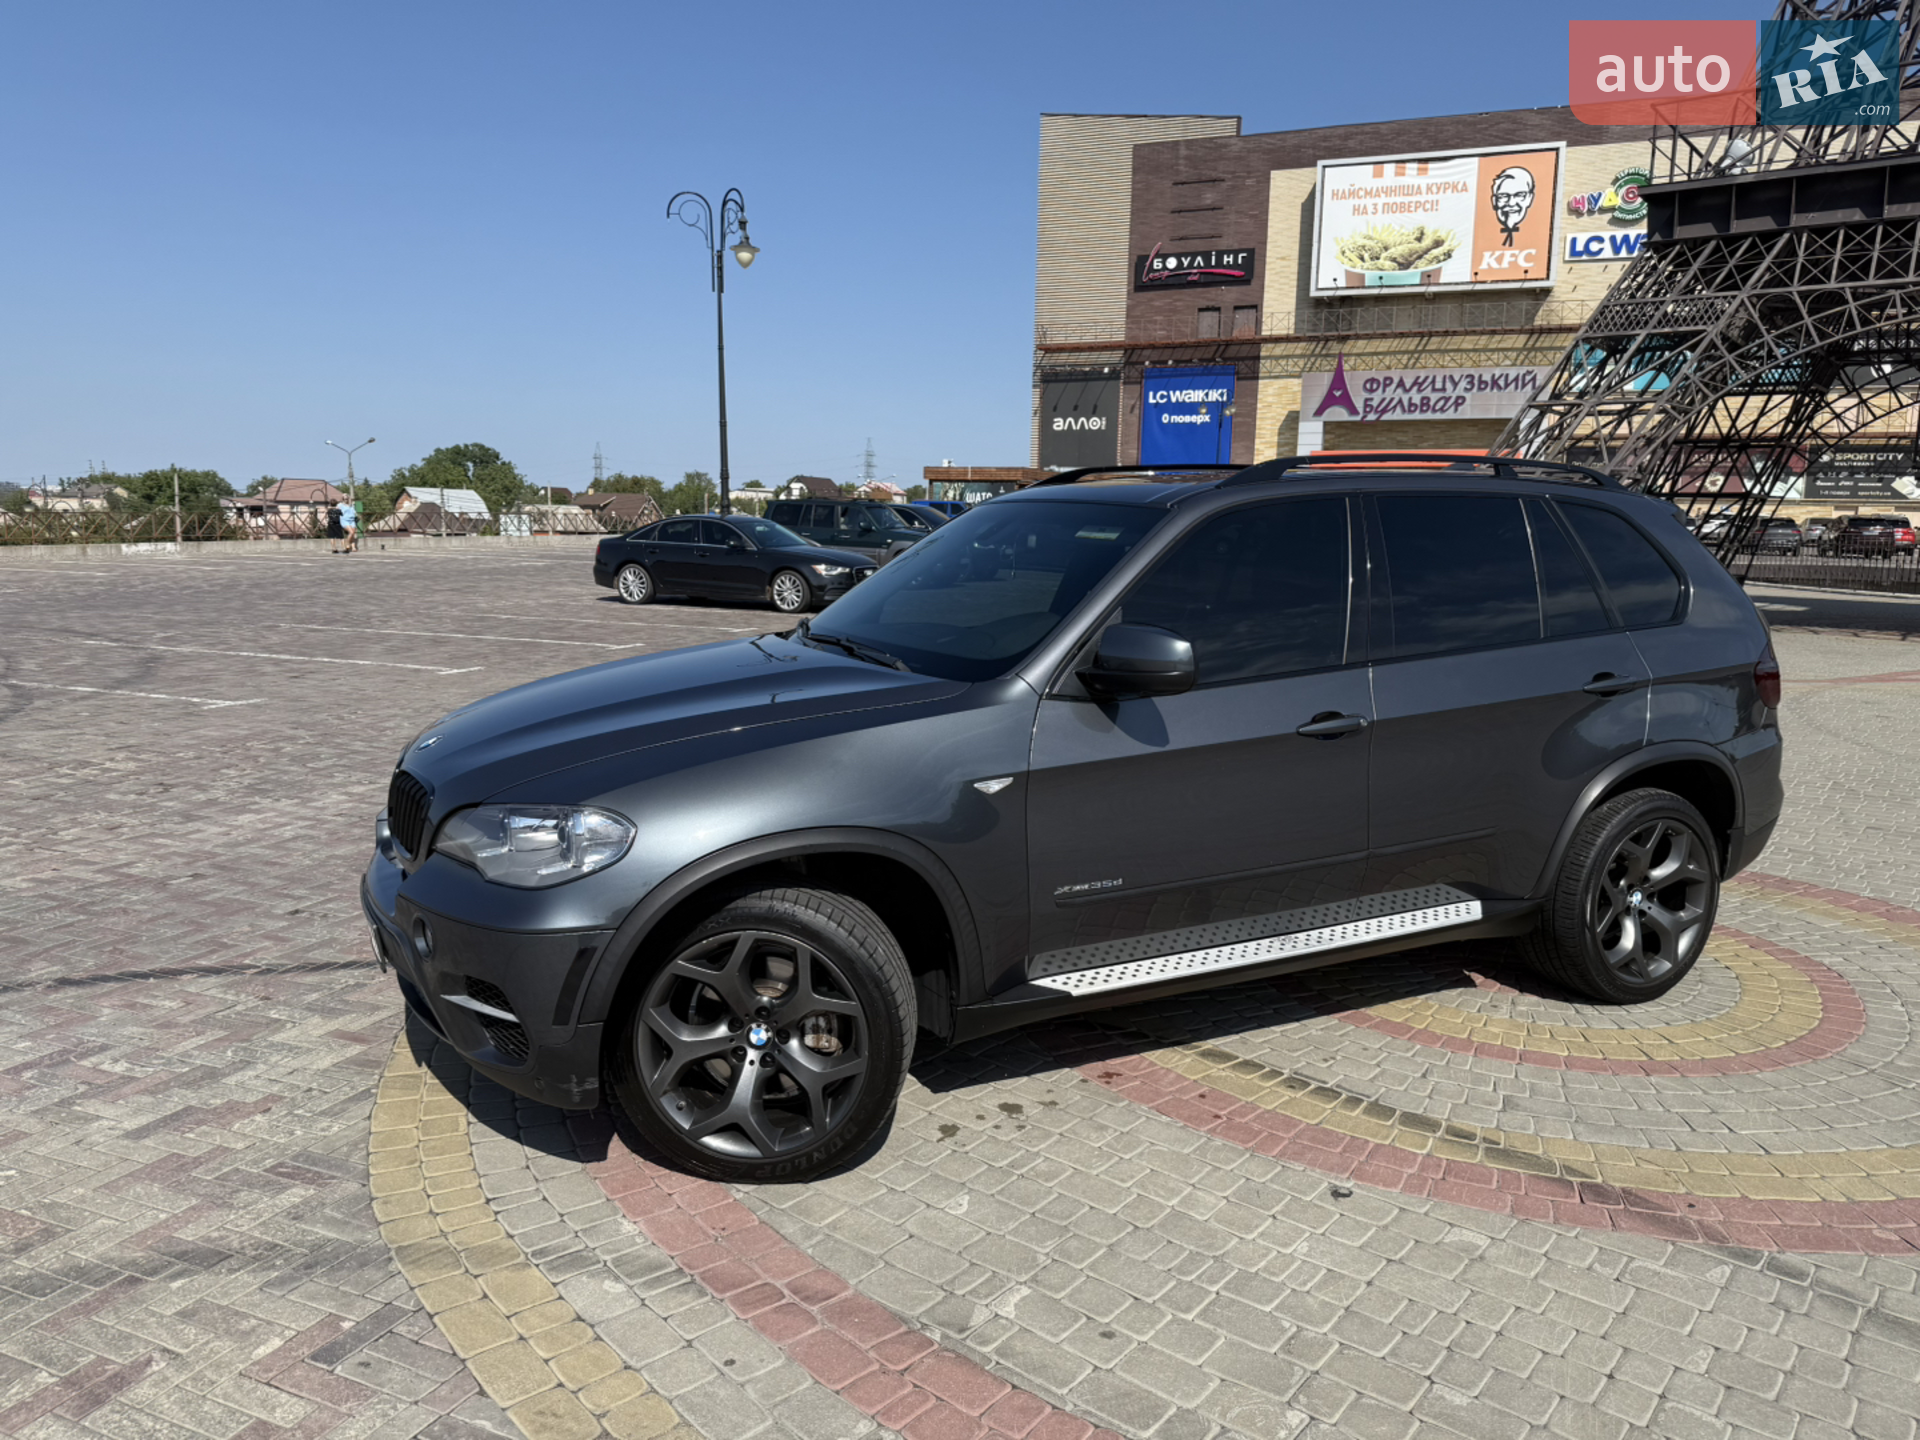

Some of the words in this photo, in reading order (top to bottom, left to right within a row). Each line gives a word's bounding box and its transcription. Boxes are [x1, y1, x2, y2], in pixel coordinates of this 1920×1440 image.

[1331, 182, 1424, 201] НАЙСМАЧНІША
[1426, 180, 1469, 195] КУРКА
[1352, 202, 1369, 216] НА
[1371, 202, 1379, 216] 3
[1382, 199, 1440, 215] ПОВЕРСІ!
[1569, 235, 1605, 257] LC
[1479, 249, 1536, 270] KFC
[1362, 369, 1538, 394] ФРАНЦУЗЬКИЙ
[1148, 390, 1168, 404] LC
[1162, 413, 1170, 424] 0
[1170, 413, 1211, 425] поверх
[1835, 452, 1905, 461] SPORTCITY
[755, 1122, 859, 1178] DUNLOP
